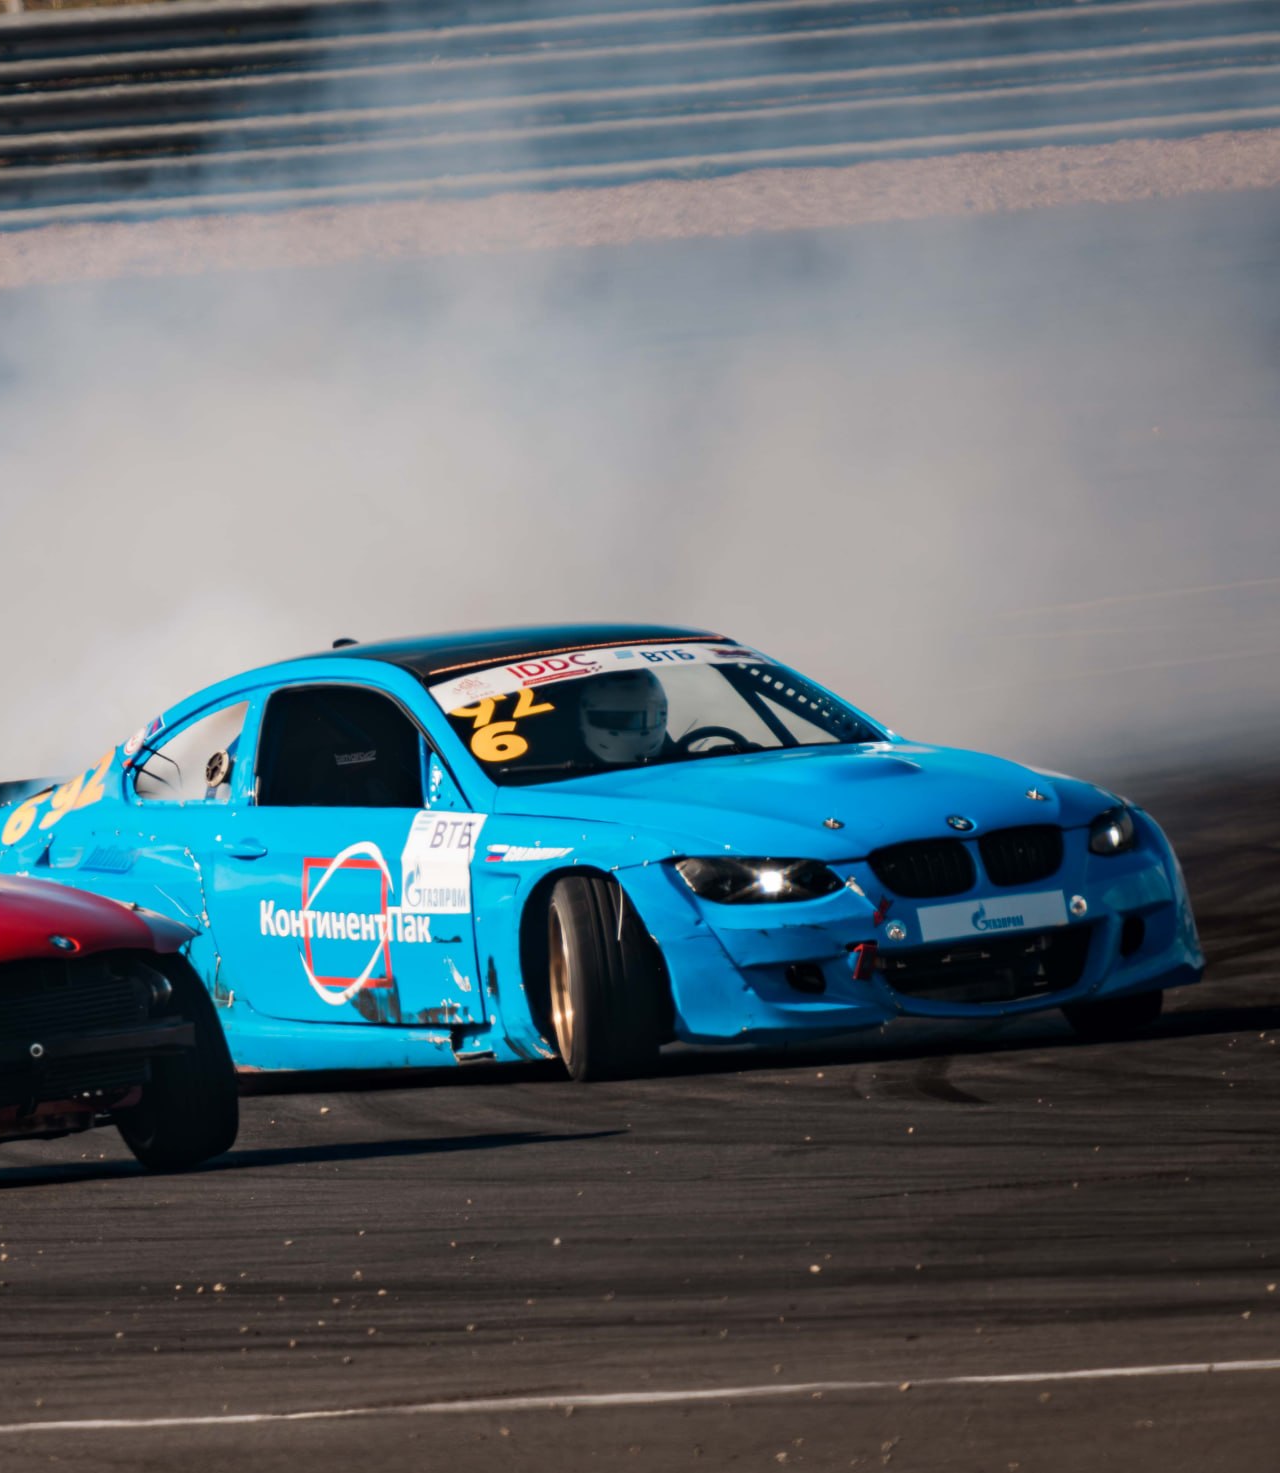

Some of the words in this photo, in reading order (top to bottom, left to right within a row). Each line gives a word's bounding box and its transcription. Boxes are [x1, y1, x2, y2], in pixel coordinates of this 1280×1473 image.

[505, 653, 597, 679] IDDC
[640, 649, 696, 663] ВТБ
[470, 720, 529, 762] 6
[429, 821, 477, 849] ВТБ
[422, 887, 467, 908] ГАЗПРОМ
[259, 899, 433, 943] КонтинентПак
[986, 914, 1025, 930] ГАЗПРОМ
